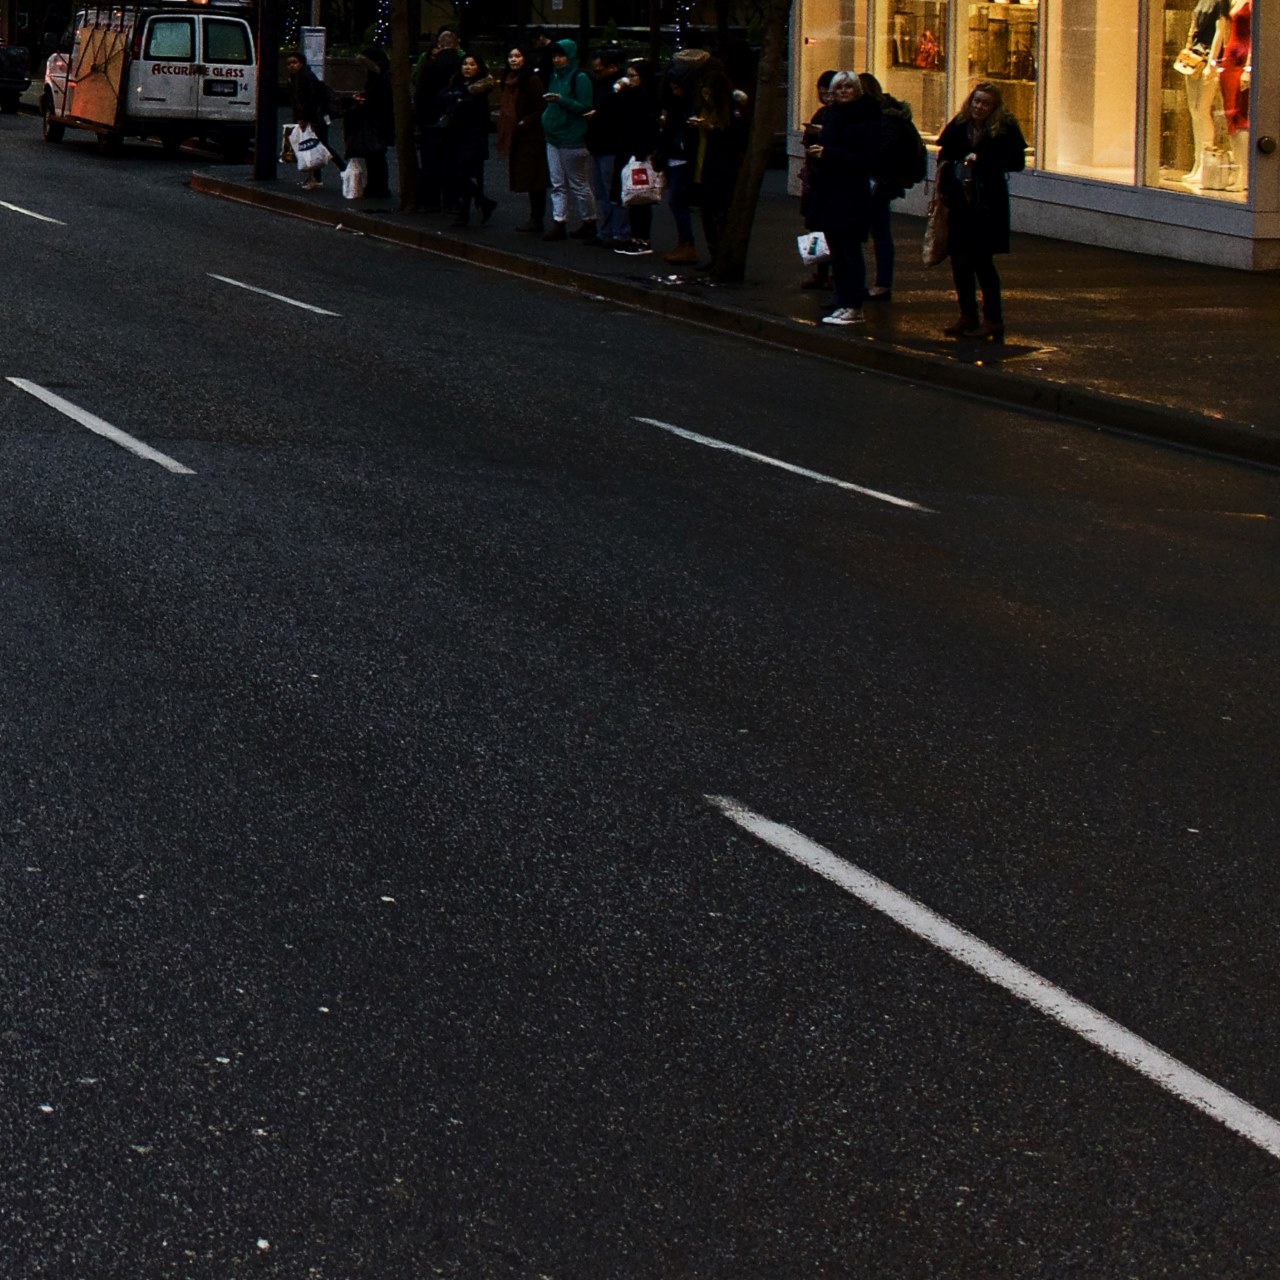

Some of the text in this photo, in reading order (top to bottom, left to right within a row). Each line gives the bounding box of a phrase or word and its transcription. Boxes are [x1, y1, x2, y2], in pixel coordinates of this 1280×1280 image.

[152, 63, 245, 78] ACCURAE GLASS
[239, 83, 248, 91] 14
